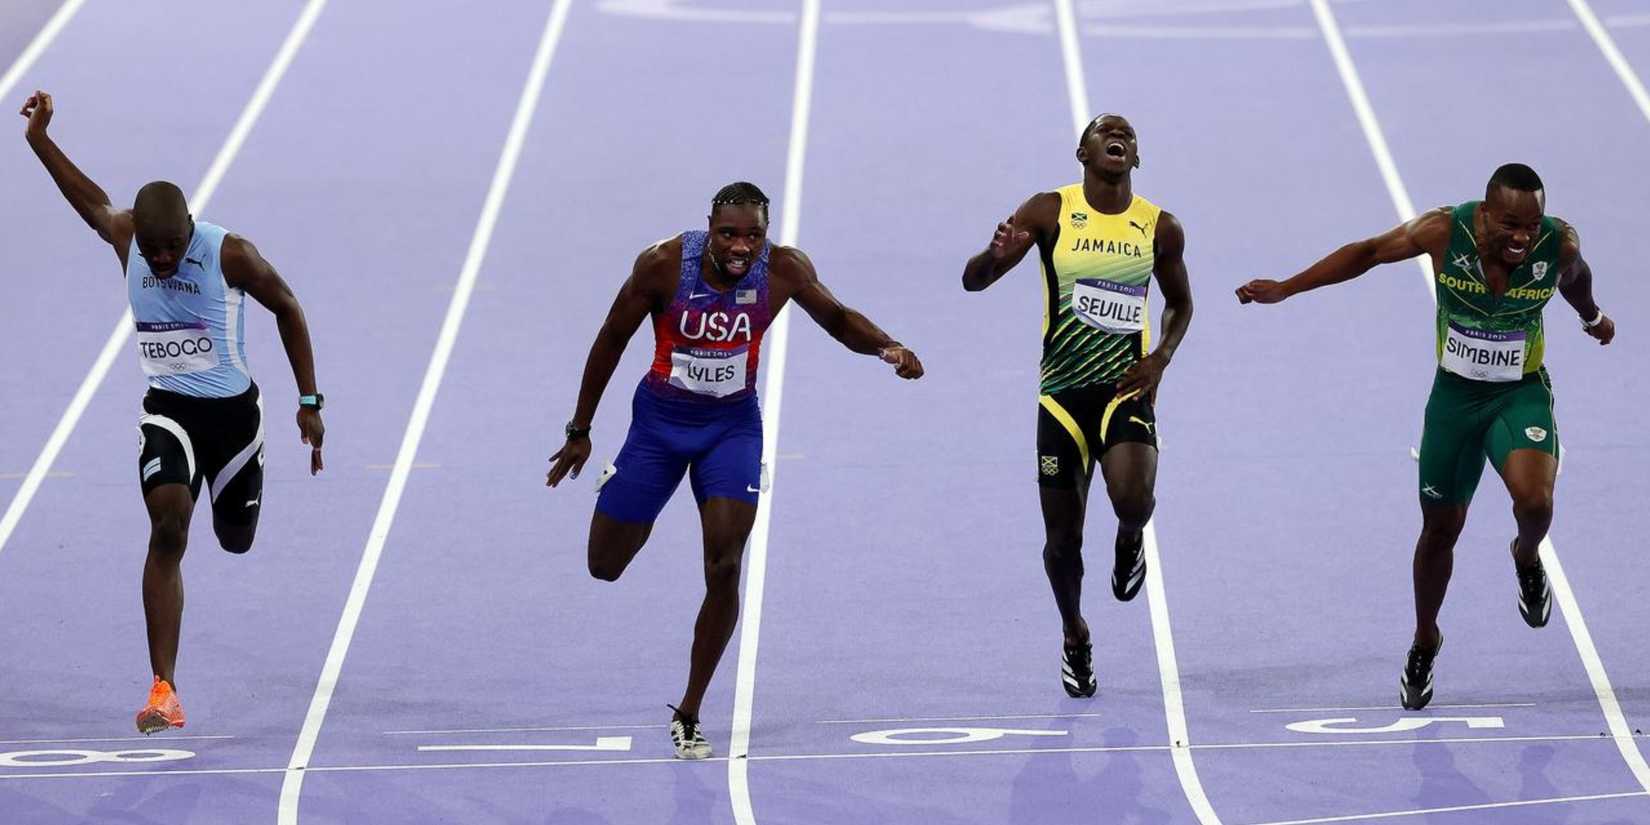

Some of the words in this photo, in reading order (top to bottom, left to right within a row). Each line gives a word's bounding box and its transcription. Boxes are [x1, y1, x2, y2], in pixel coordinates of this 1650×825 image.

[1072, 239, 1142, 258] JAMAICA
[1439, 273, 1486, 294] SOUTH
[1078, 295, 1142, 323] SEVILLE
[680, 310, 751, 342] USA
[140, 336, 213, 359] TEBOGO
[1446, 337, 1521, 367] SIMBINE
[687, 361, 735, 382] LYLES
[1285, 716, 1505, 734] 5
[0, 749, 196, 767] 8
